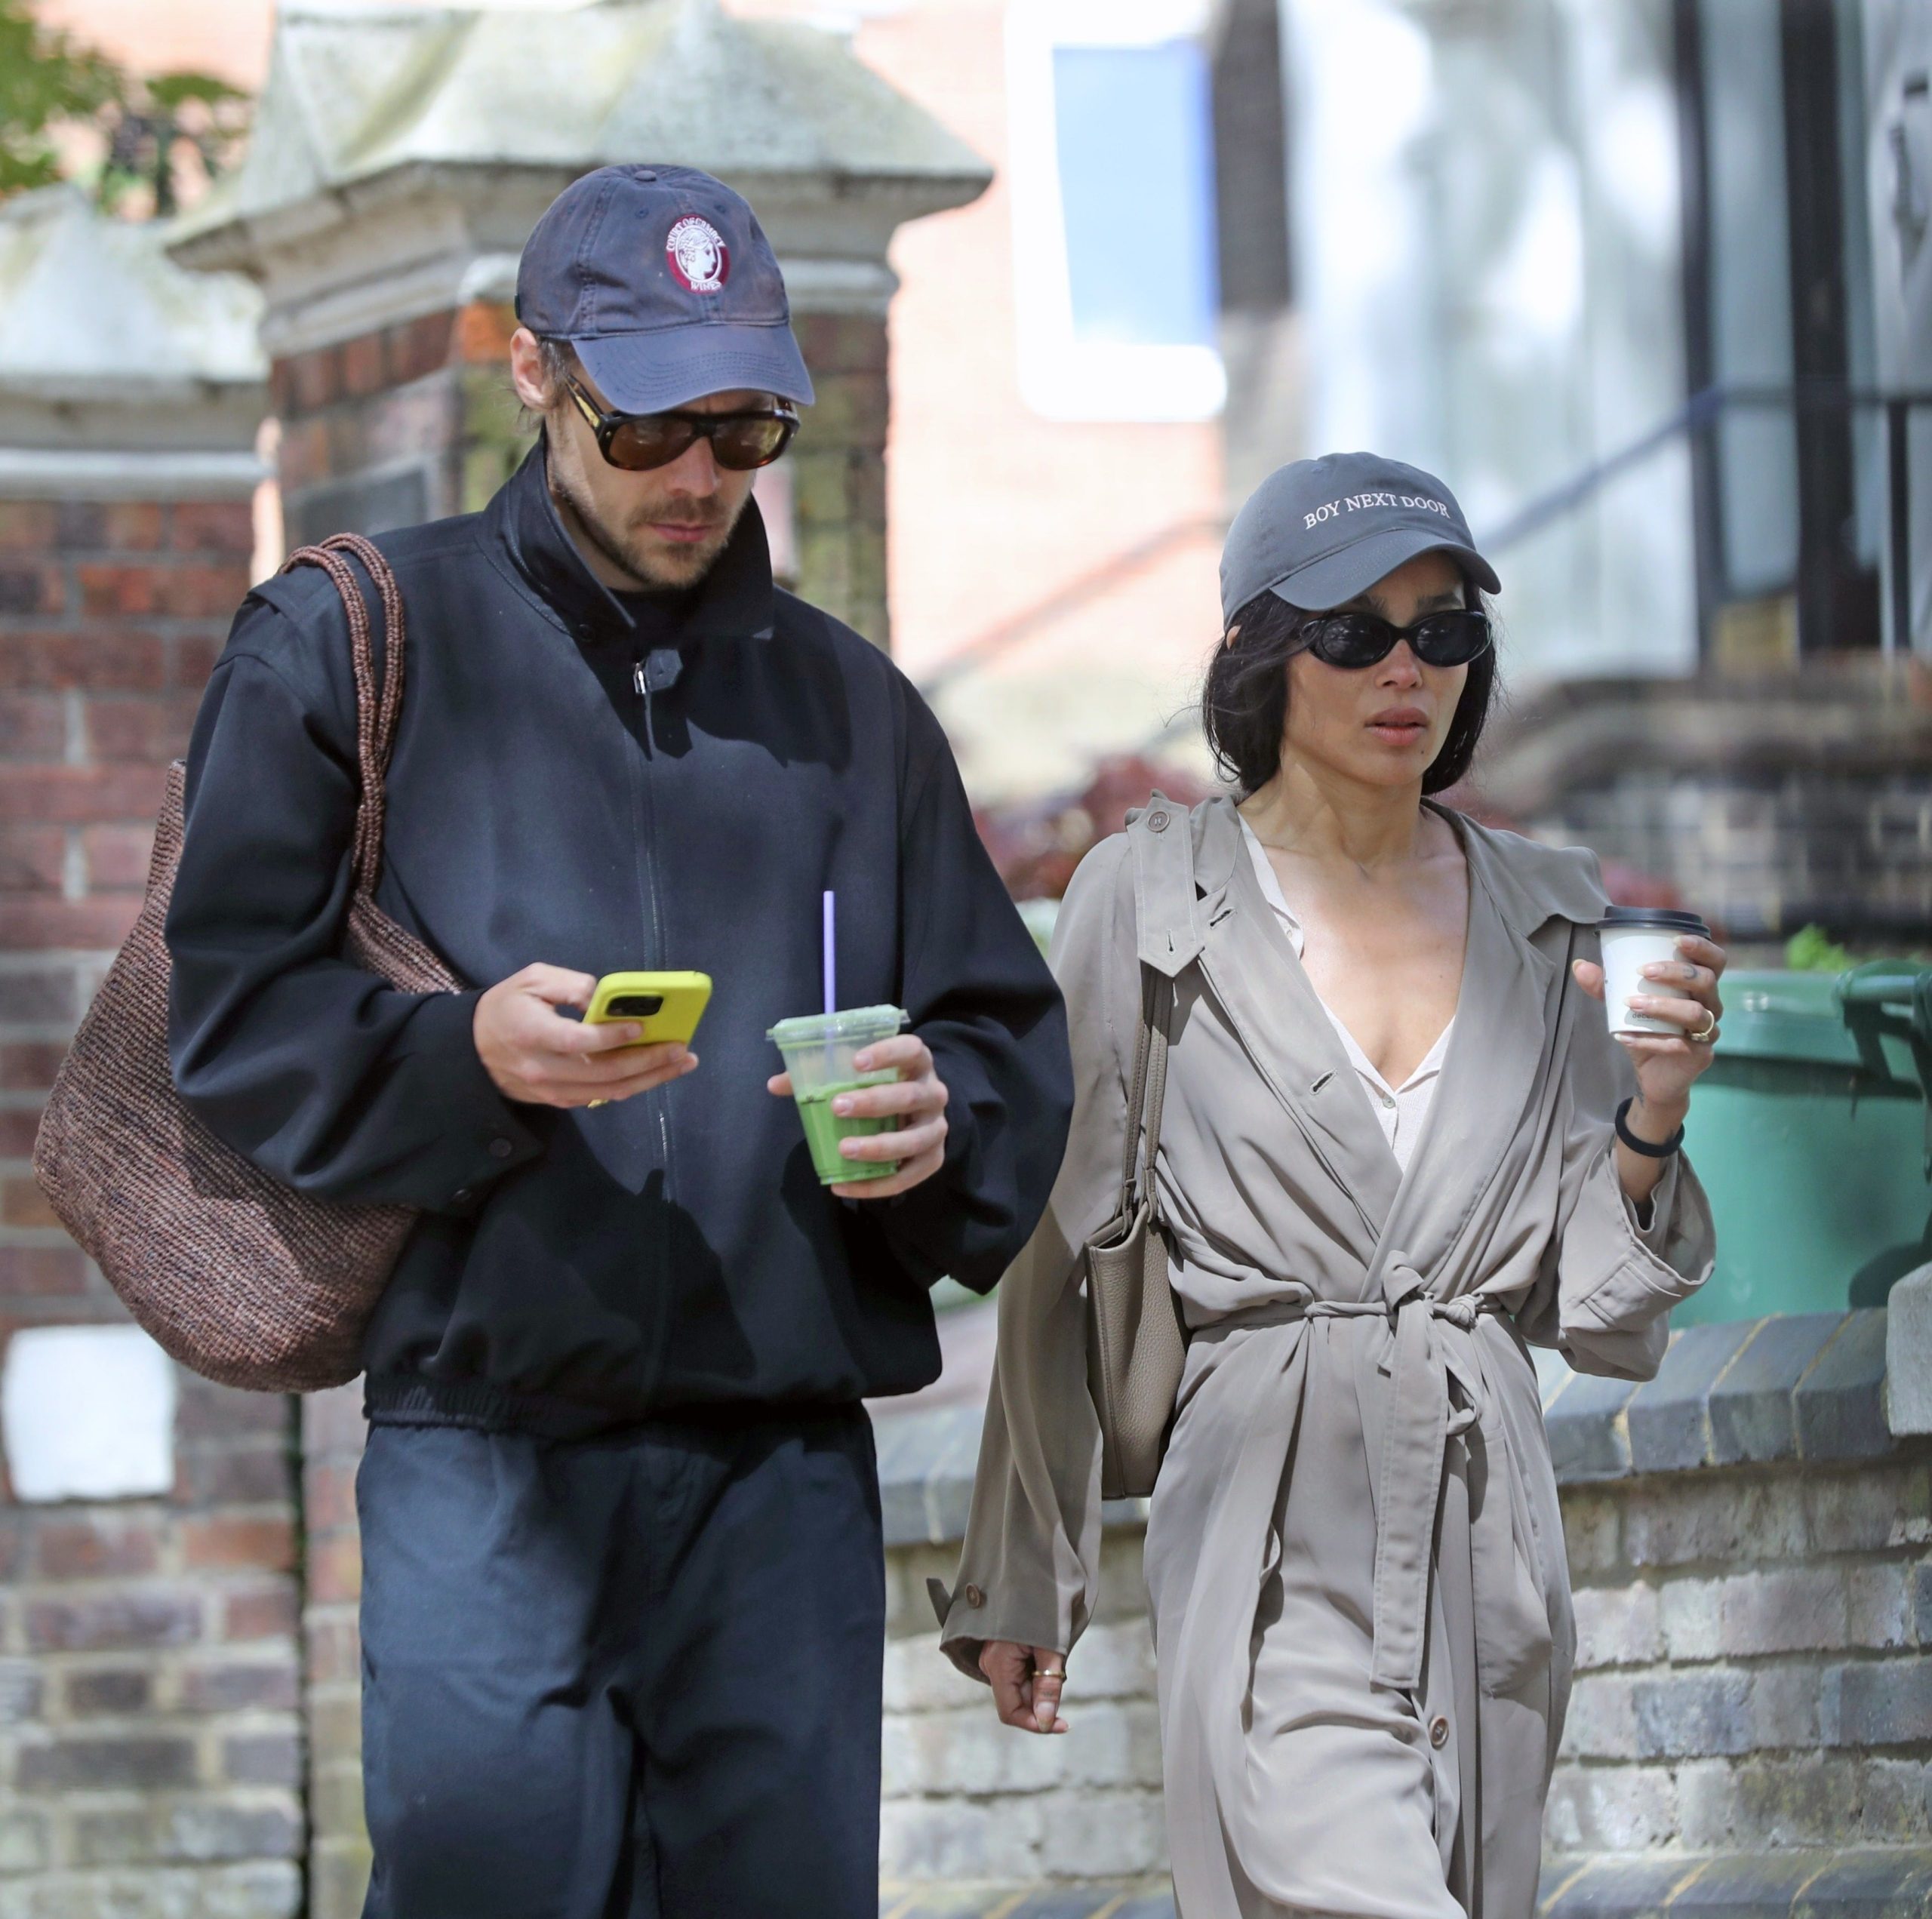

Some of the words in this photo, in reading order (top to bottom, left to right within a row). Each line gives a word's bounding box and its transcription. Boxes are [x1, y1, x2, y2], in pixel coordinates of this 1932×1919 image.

[681, 217, 695, 226] OF
[1303, 500, 1340, 530] BOY
[1343, 493, 1398, 512] NEXT
[1400, 496, 1451, 518] DOOR
